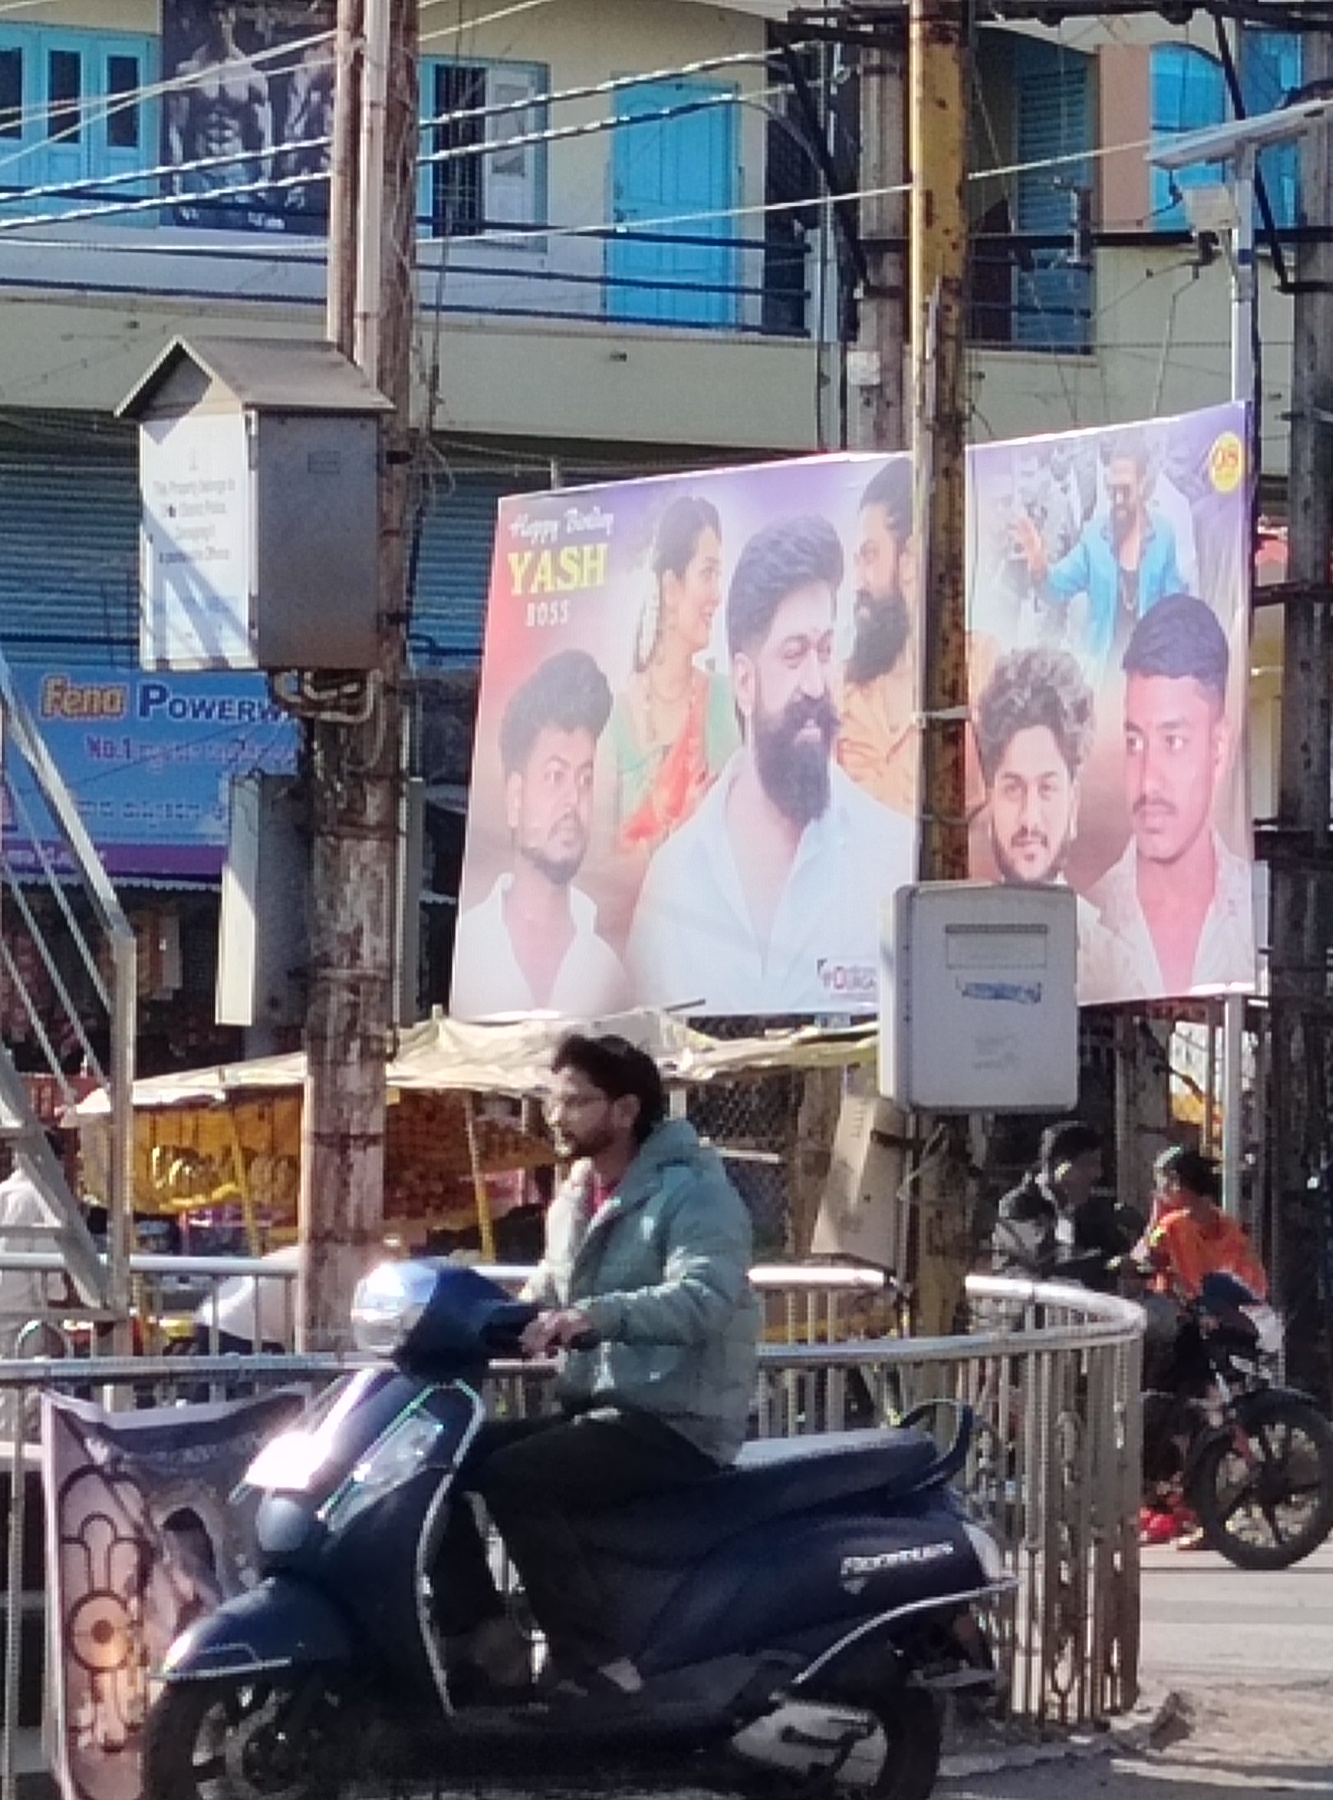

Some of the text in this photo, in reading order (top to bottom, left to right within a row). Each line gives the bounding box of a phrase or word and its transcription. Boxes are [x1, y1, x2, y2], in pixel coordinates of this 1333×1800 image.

[507, 544, 608, 596] YASH
[526, 599, 568, 628] BOSS
[41, 674, 127, 721] Fena
